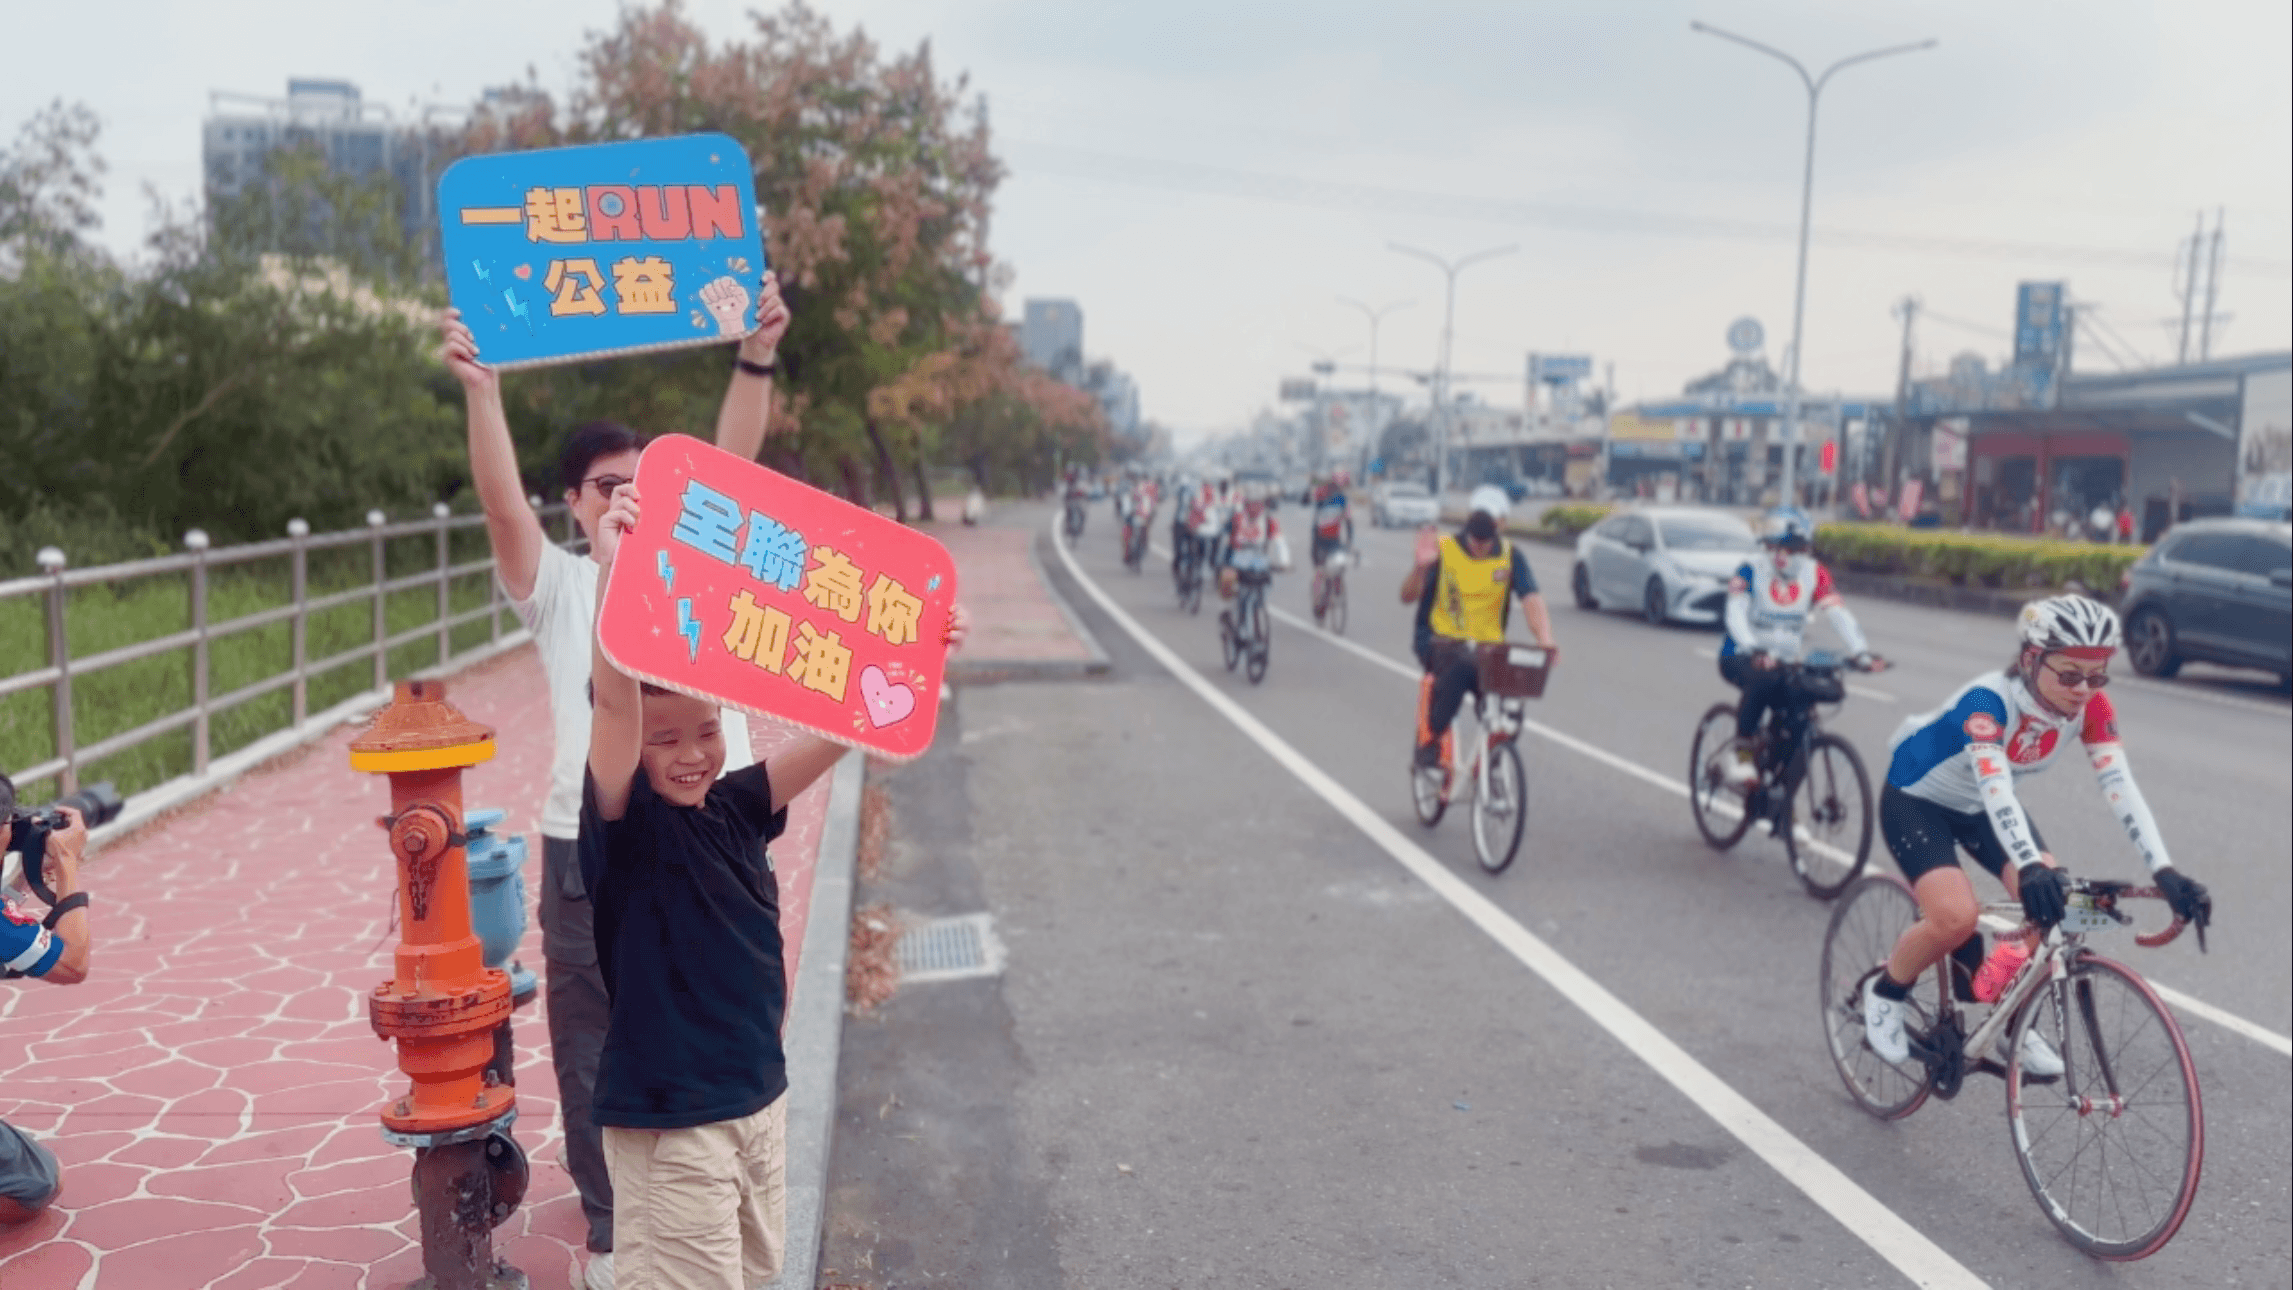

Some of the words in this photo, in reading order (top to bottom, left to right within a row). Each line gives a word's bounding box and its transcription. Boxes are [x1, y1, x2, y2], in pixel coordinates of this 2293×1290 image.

[459, 184, 745, 244] 一起RUN
[543, 255, 678, 317] 公益
[671, 478, 925, 646] 全聯為你
[722, 588, 854, 704] 加油
